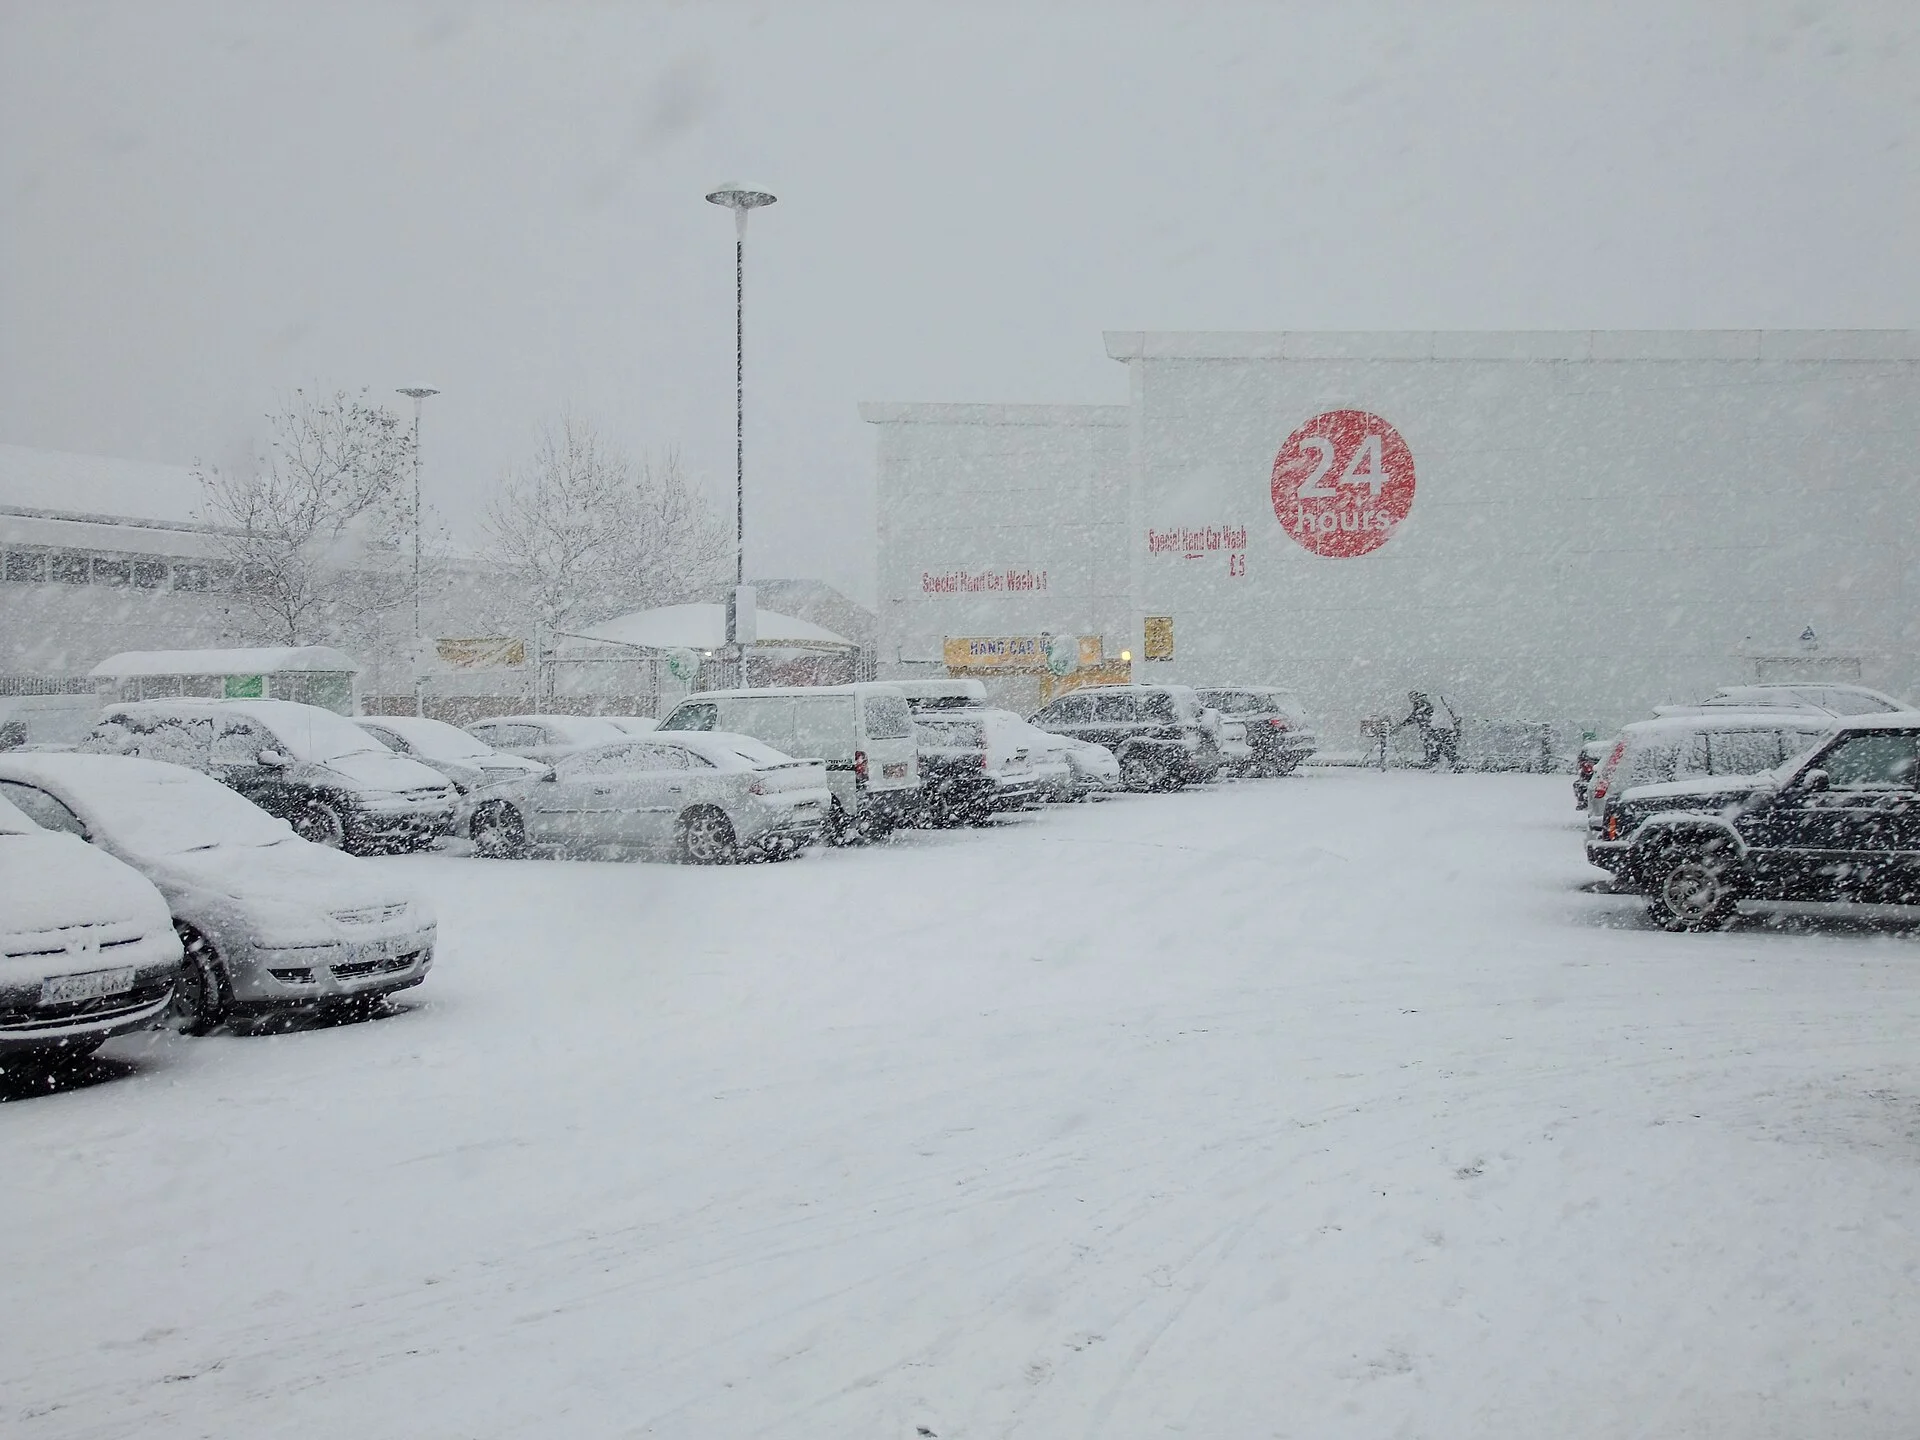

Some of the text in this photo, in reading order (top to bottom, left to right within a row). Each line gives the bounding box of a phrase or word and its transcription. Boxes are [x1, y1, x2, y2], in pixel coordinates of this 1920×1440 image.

[1297, 434, 1390, 499] 24
[1295, 502, 1391, 534] hours
[1149, 525, 1247, 557] Special Hand Car Wash
[922, 571, 958, 597] Special
[960, 571, 985, 592] Hand
[987, 570, 1003, 591] Car
[1006, 569, 1033, 591] Wash
[970, 640, 1005, 655] HAND
[1009, 640, 1035, 655] CAR
